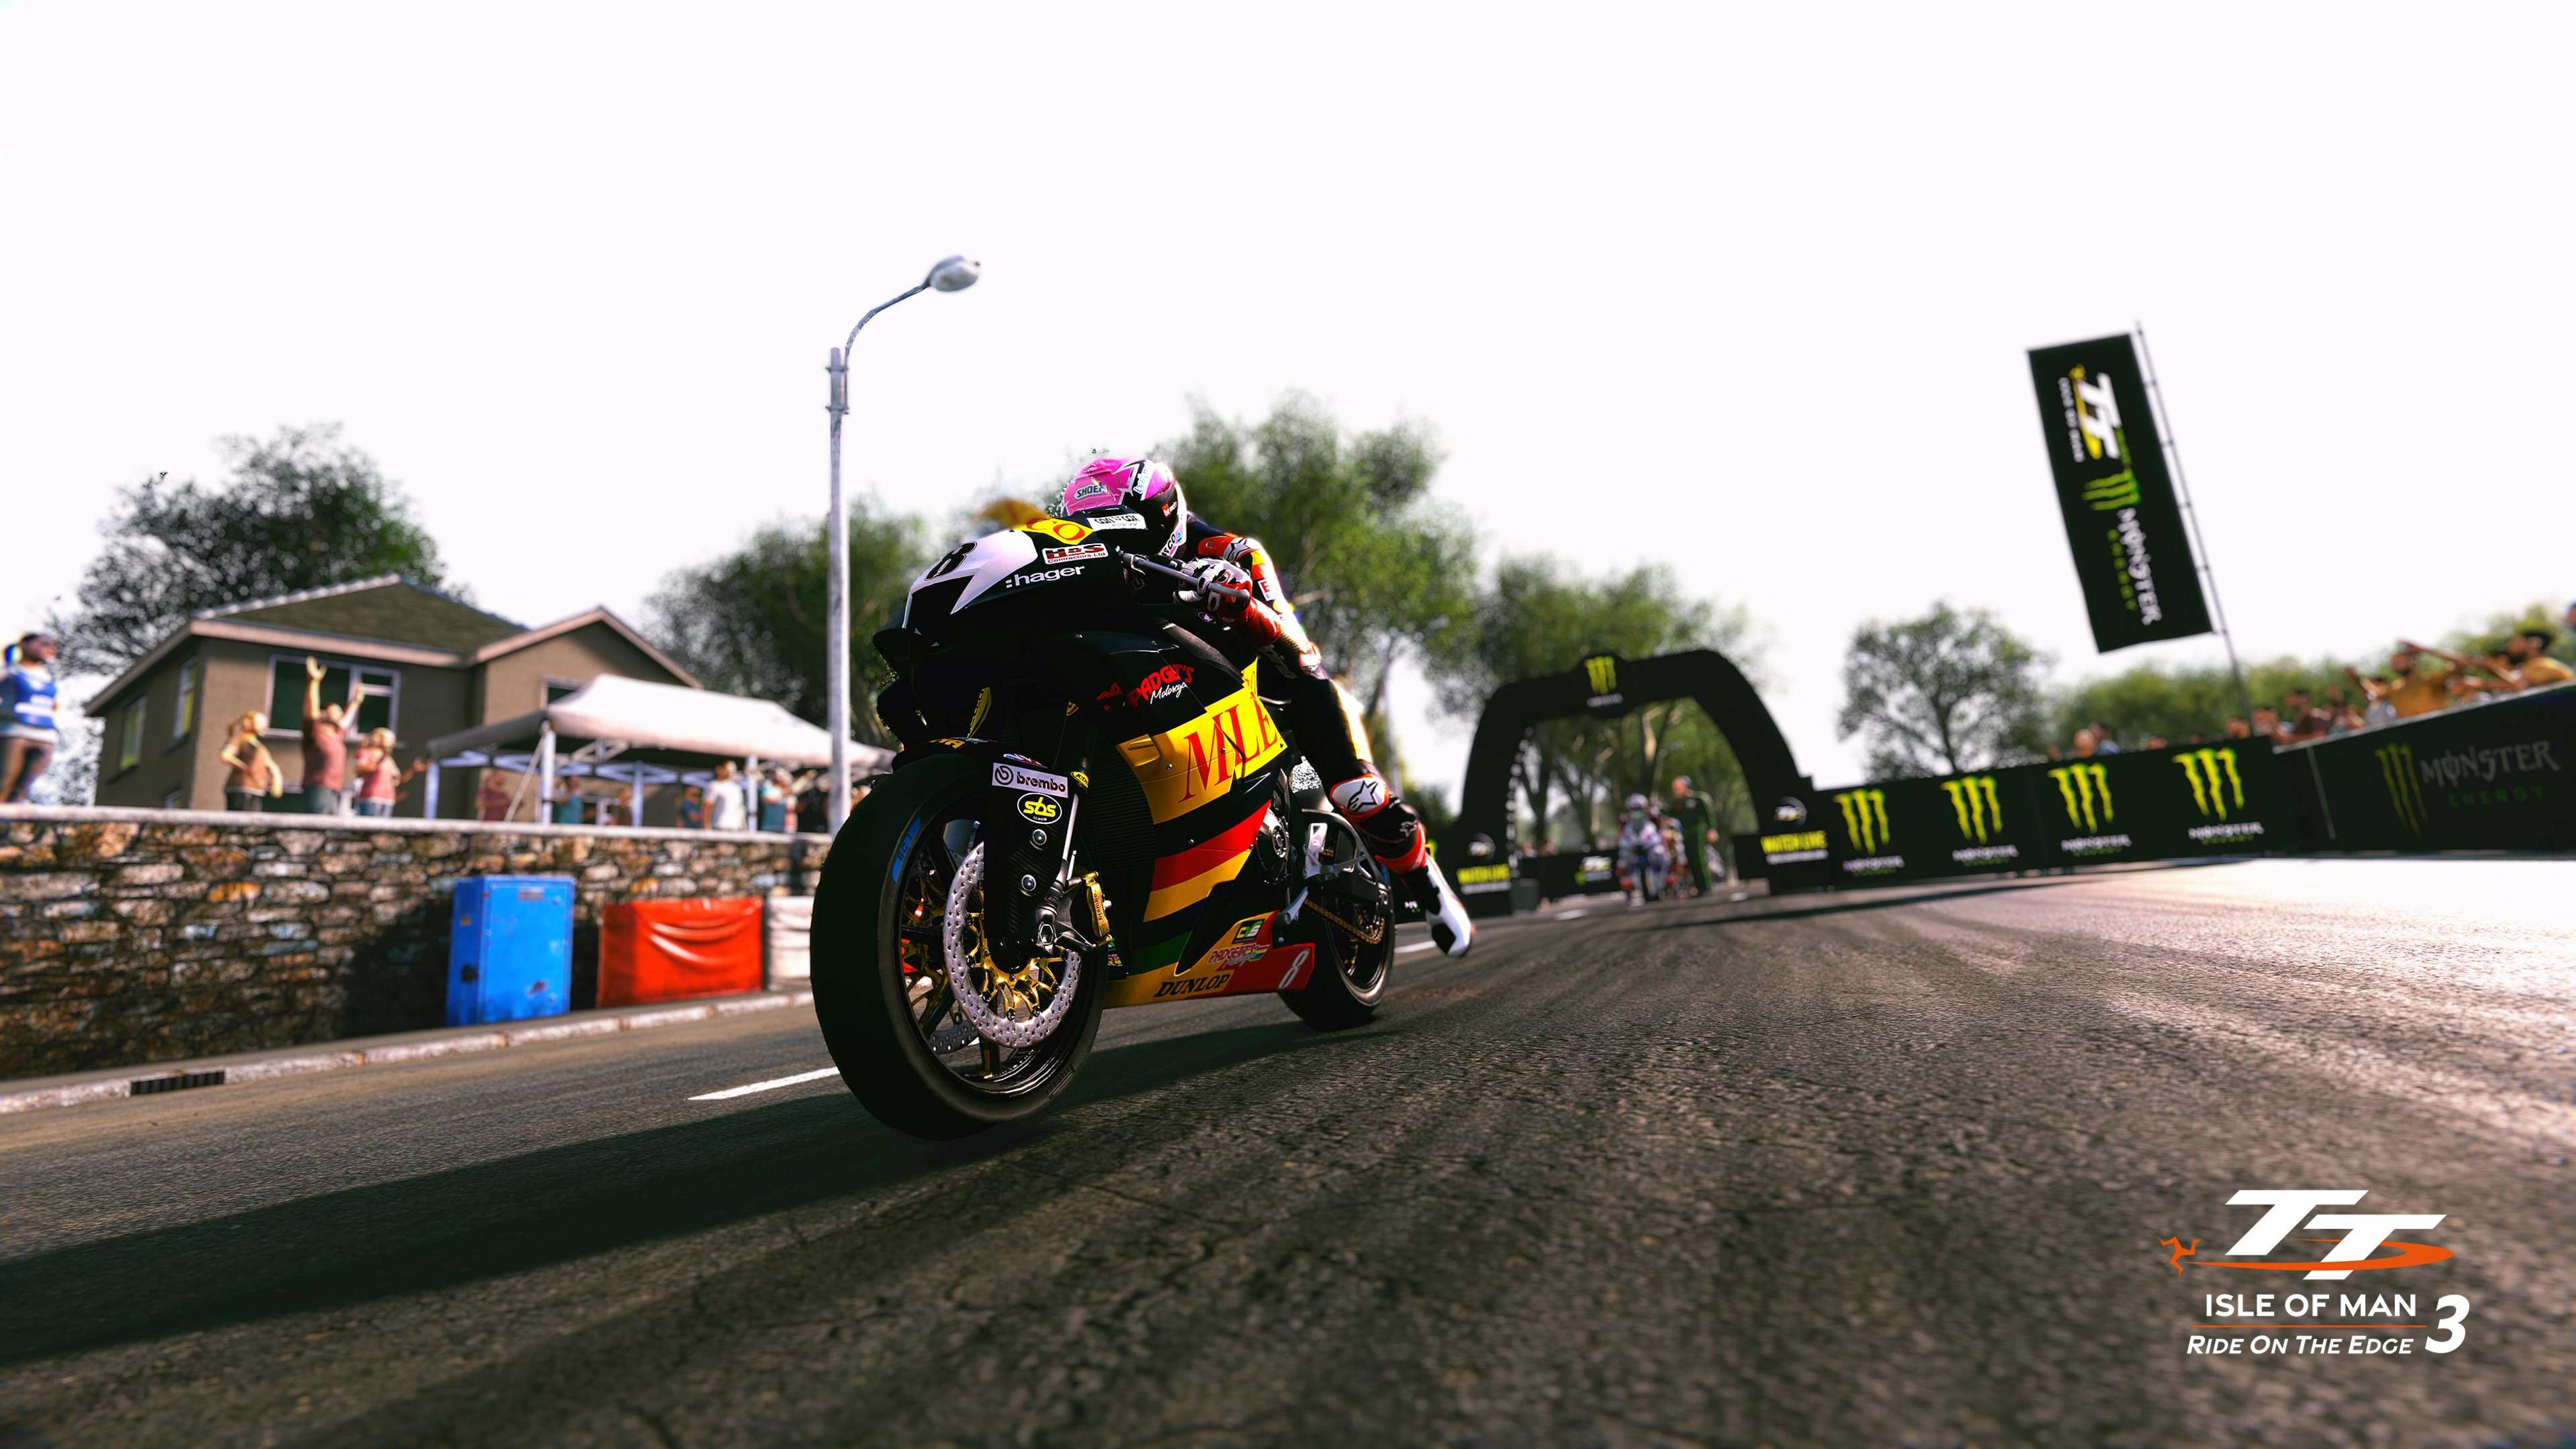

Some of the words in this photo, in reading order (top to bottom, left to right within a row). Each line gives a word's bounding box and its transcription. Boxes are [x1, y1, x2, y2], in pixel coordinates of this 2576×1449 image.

[2419, 740, 2561, 788] MONSTER
[1017, 771, 1066, 792] brembo
[1023, 797, 1057, 818] sbs
[1277, 948, 1311, 991] 8
[1153, 973, 1232, 997] DUNLOP
